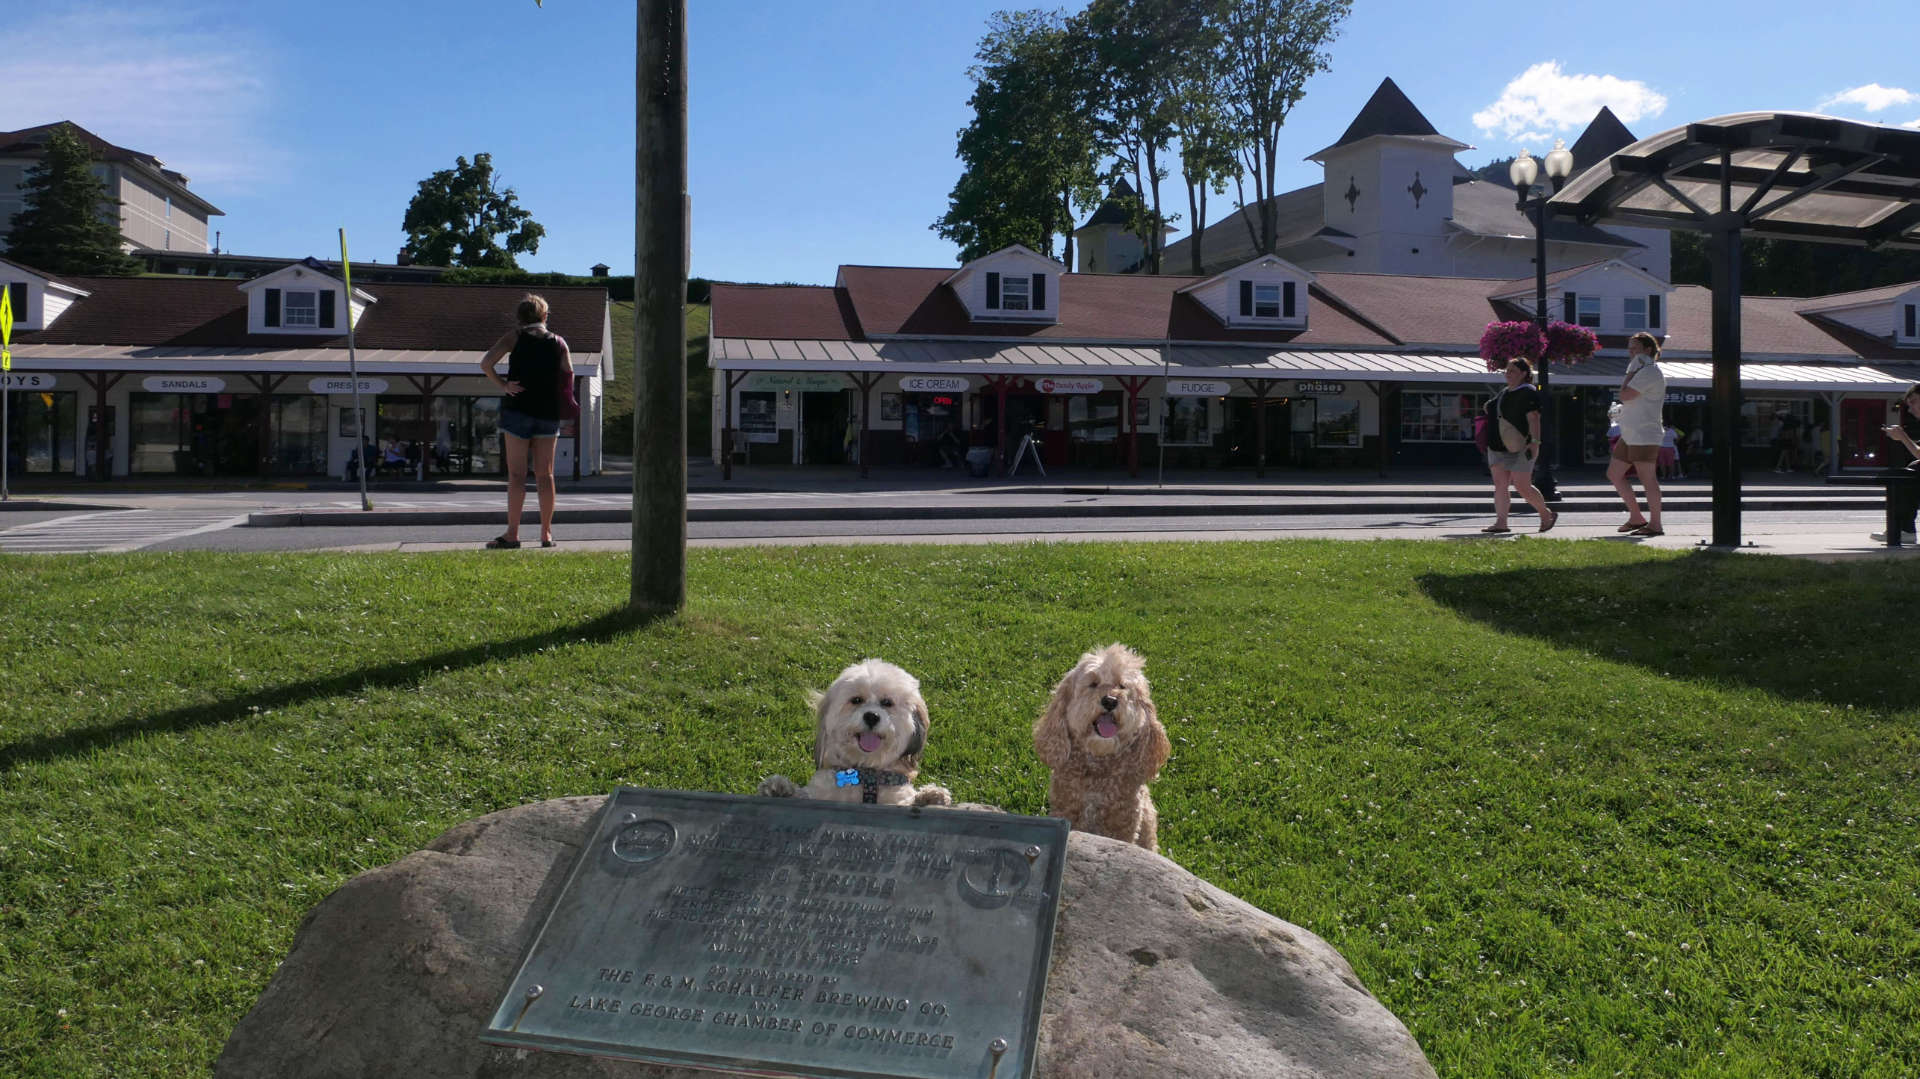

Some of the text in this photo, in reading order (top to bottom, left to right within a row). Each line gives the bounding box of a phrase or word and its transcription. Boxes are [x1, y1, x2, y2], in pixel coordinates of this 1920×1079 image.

[1, 376, 41, 386] OYS
[161, 380, 208, 389] SANDALS
[327, 381, 370, 390] DRESES
[909, 379, 960, 389] ICE CREAM
[1181, 383, 1215, 393] FUDGE
[1299, 383, 1343, 392] phases
[933, 396, 953, 405] OPEN
[1663, 392, 1707, 403] esign
[599, 968, 950, 1018] THE F. & M. SCHAEFER BREWING CO.
[750, 1001, 778, 1012] AND
[569, 995, 955, 1049] LAKE GEORGE CHAMBER OF COMMERCE
